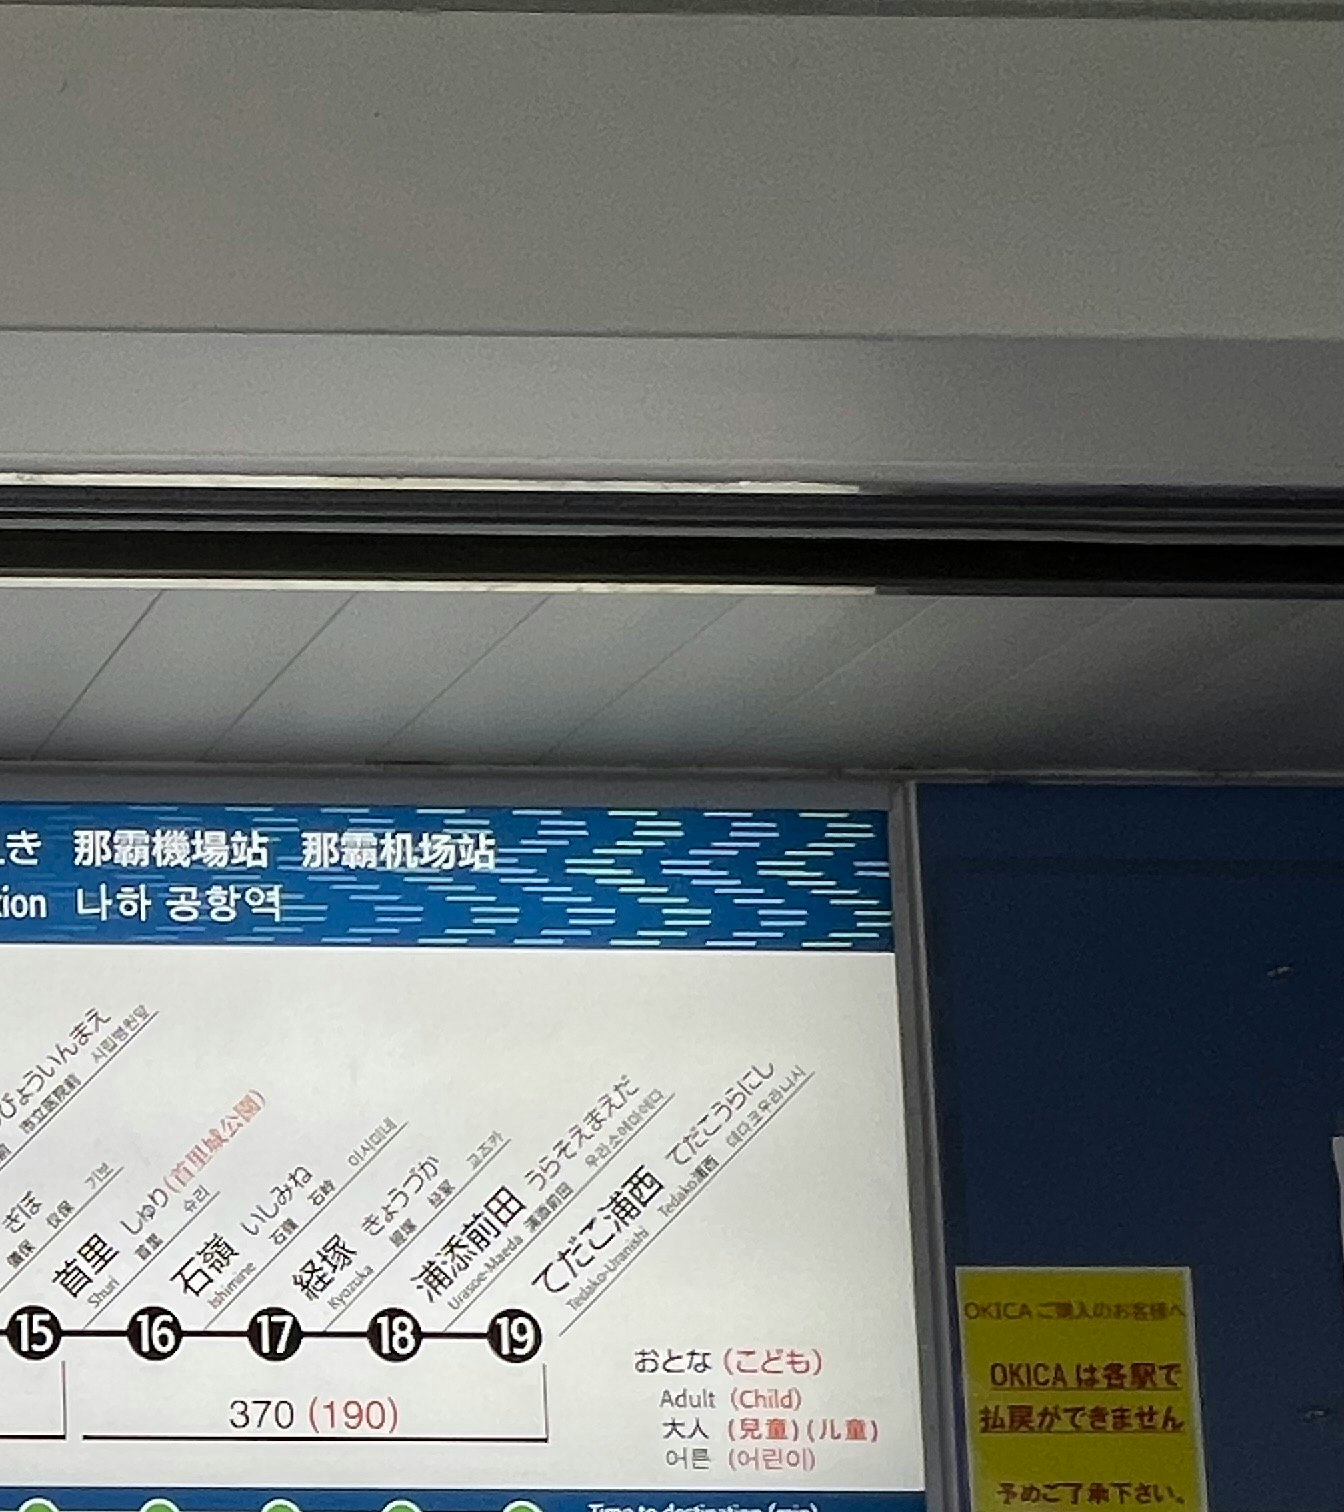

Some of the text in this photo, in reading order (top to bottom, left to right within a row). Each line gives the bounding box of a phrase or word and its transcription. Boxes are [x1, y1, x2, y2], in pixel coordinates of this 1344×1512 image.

[76, 884, 282, 922] 나하 공항역
[239, 1164, 316, 1237] いしみね
[409, 1184, 528, 1303] 浦添前田
[530, 1163, 666, 1297] てだこ浦西
[50, 1231, 121, 1300] 首里
[291, 1233, 358, 1302] 経塚
[633, 1347, 824, 1376] おとな (こども)
[990, 1362, 1067, 1388] OKICA
[229, 1397, 400, 1434] 370 (190)
[659, 1387, 803, 1412] Adult (Child)
[662, 1418, 711, 1442] 大人
[665, 1446, 816, 1472] 어른 (어린이)
